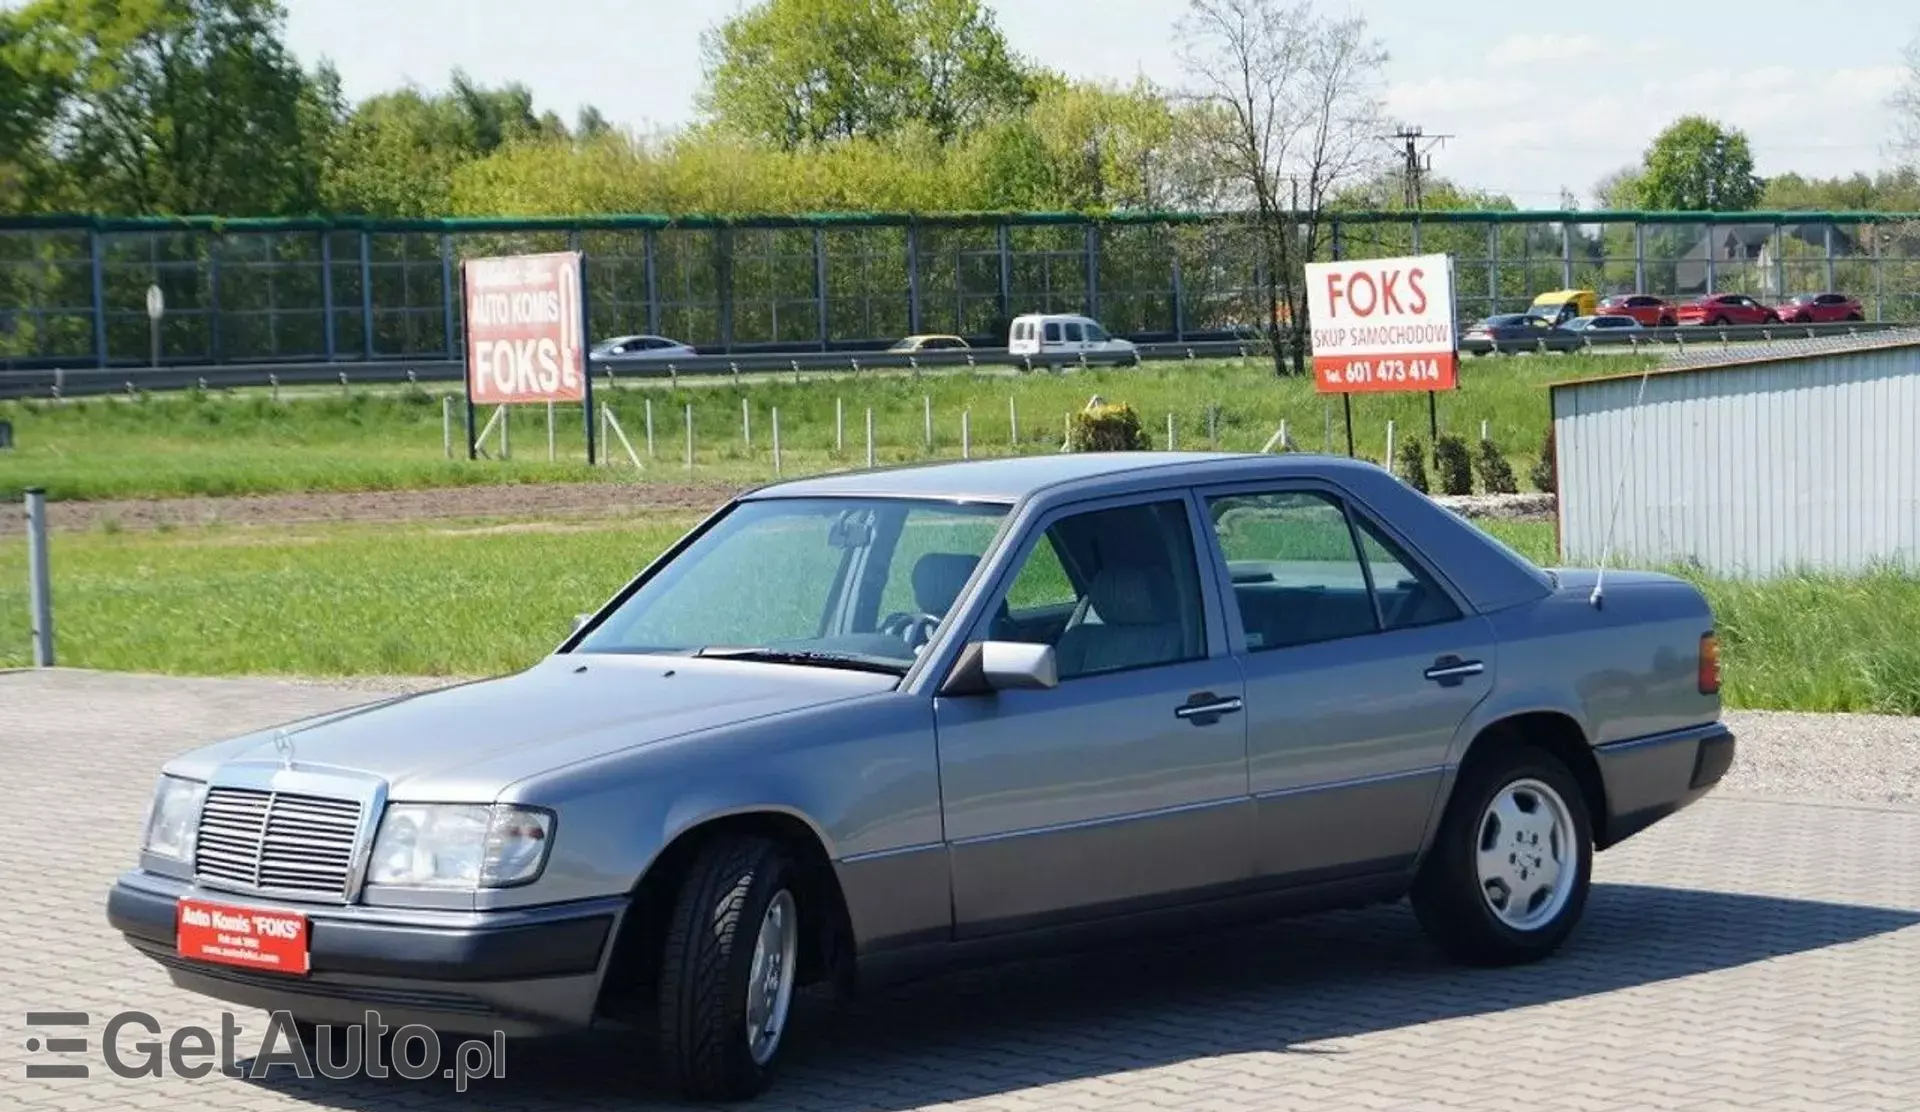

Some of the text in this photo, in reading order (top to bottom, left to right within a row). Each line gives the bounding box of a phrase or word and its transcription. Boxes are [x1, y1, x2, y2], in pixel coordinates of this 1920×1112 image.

[1327, 267, 1427, 318] FOKS
[471, 290, 560, 326] AUTO KOMIS
[1314, 328, 1346, 348] SKUP
[1345, 361, 1372, 383] 601
[1376, 360, 1406, 382] 473
[1409, 358, 1439, 381] 414
[182, 906, 211, 927] Auto
[211, 911, 251, 934] Komis
